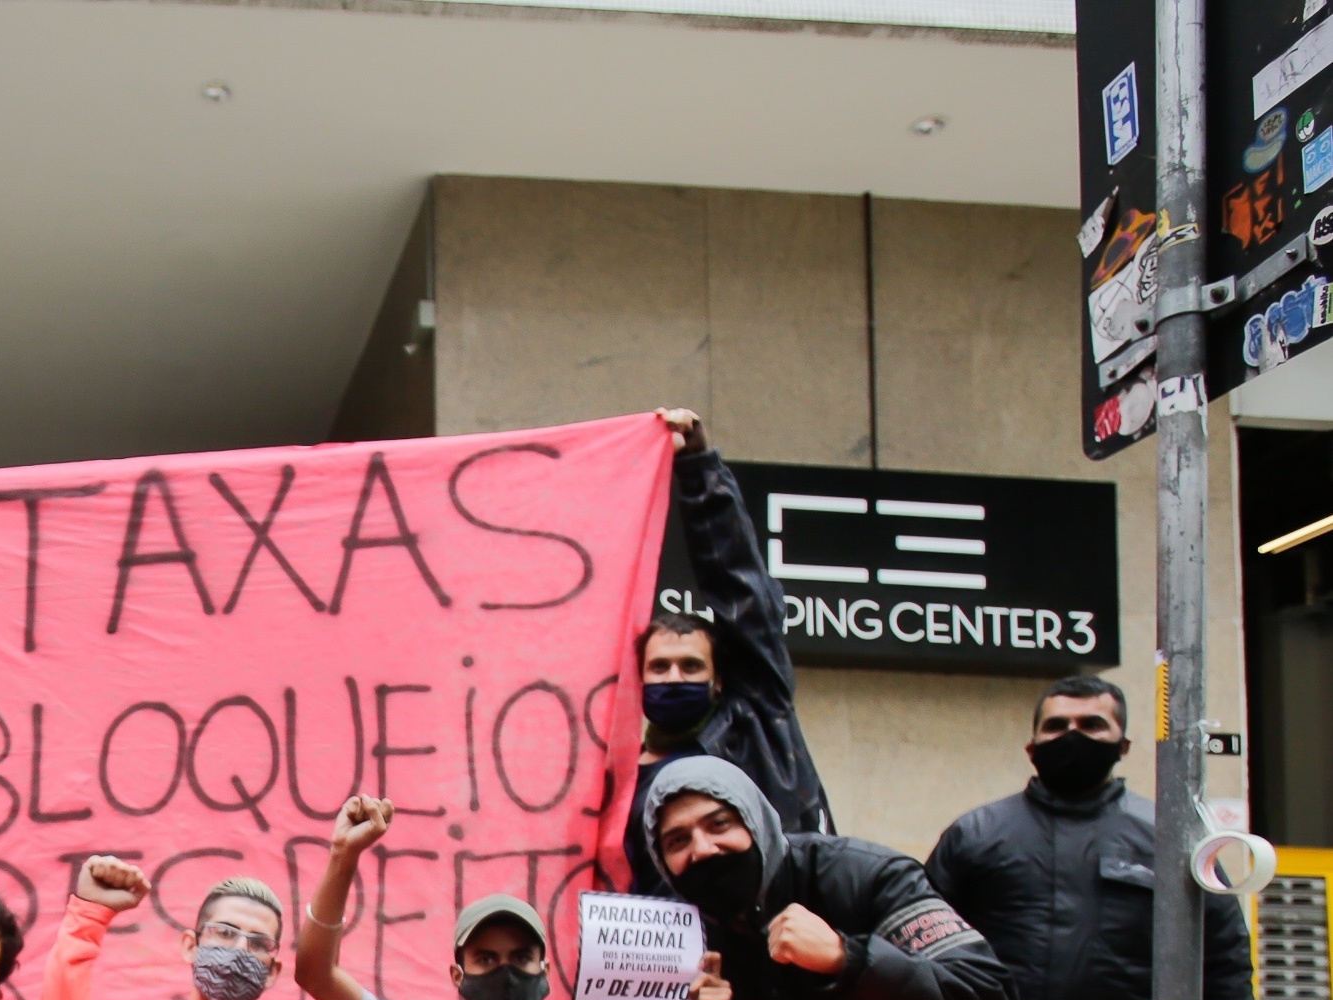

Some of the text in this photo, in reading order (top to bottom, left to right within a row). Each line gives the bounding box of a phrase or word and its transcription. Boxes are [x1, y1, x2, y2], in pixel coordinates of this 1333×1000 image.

[589, 905, 692, 928] PARALISAÇÃO
[598, 927, 686, 949] NACIONAL
[608, 979, 690, 1000] DE JULHO
